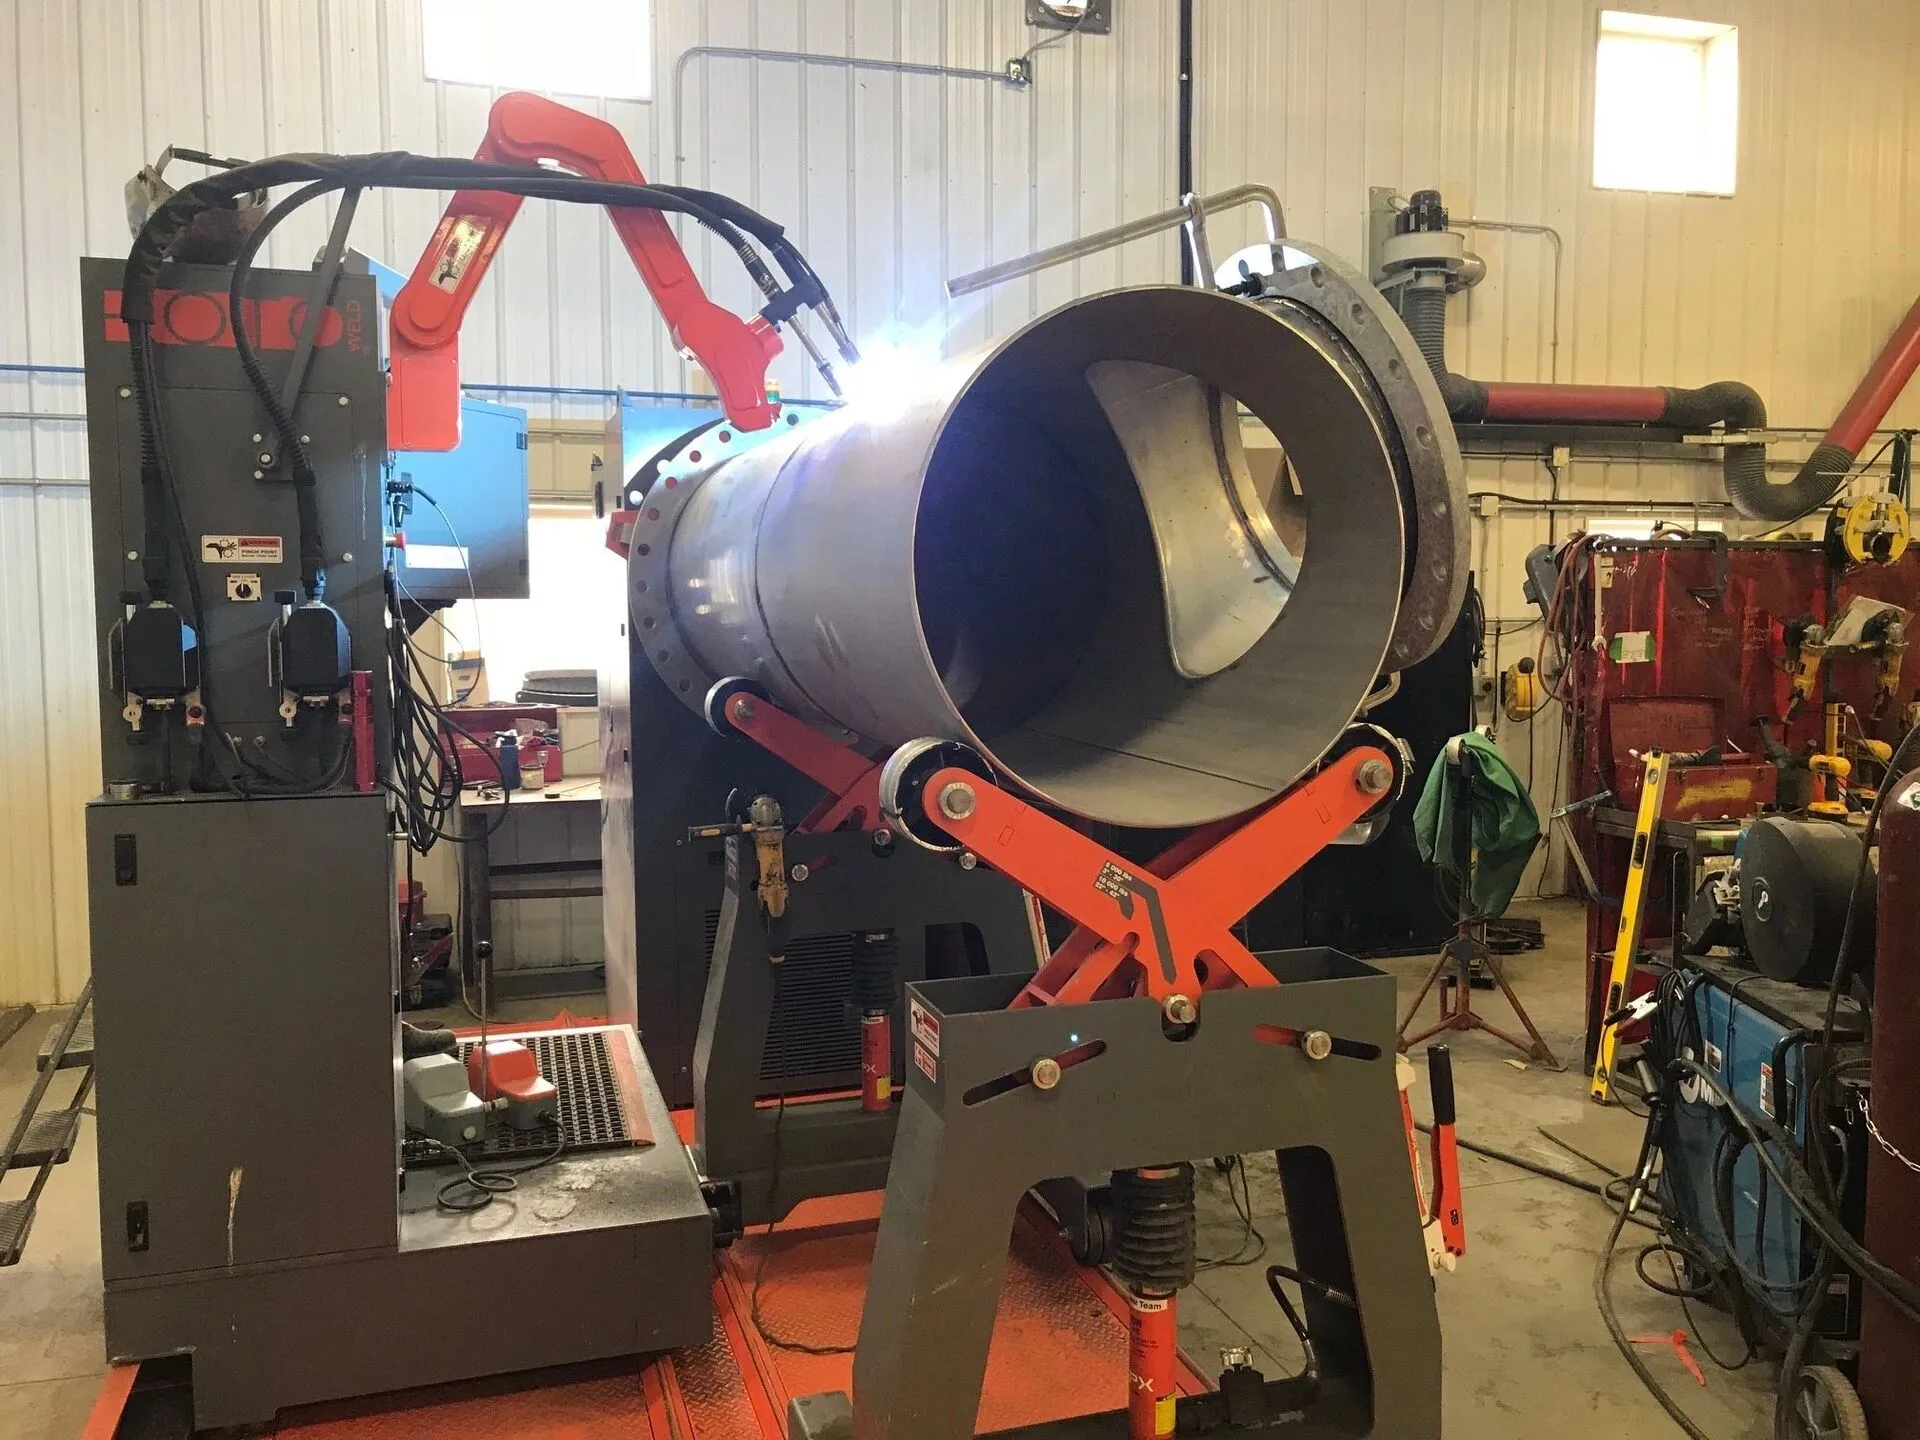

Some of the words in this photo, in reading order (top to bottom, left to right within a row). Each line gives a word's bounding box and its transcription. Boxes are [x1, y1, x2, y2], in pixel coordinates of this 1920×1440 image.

[347, 299, 362, 353] WELD
[1110, 865, 1122, 875] 000
[1122, 872, 1132, 881] lbs
[1107, 880, 1118, 890] 000
[1139, 1300, 1162, 1310] Team
